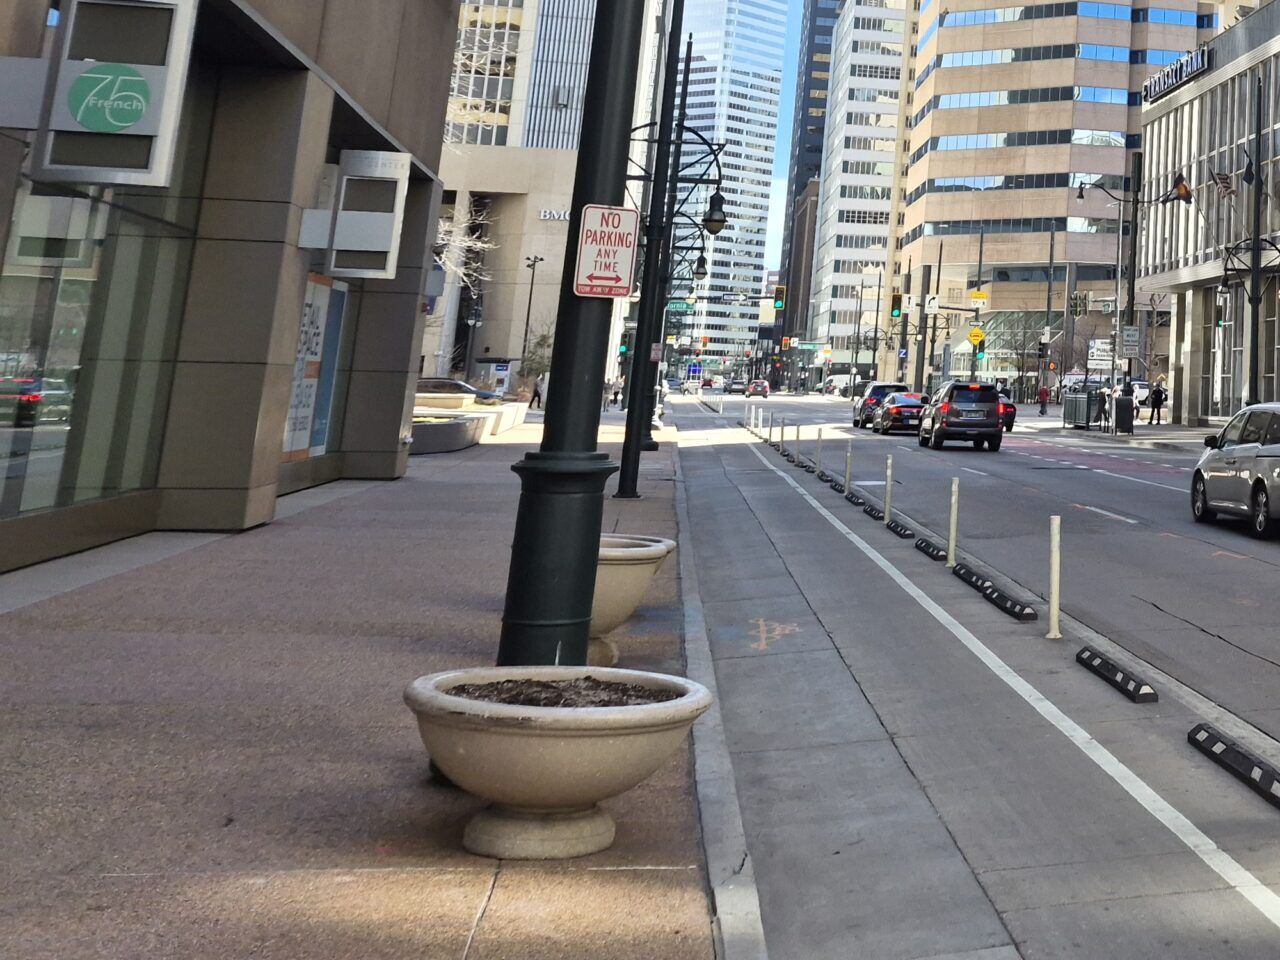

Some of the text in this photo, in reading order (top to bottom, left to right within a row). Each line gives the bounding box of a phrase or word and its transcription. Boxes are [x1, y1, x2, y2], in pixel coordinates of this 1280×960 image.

[88, 96, 143, 110] French
[600, 211, 621, 229] NO
[584, 229, 632, 248] PARKING
[596, 247, 618, 260] ANY
[593, 260, 619, 273] TIME
[578, 285, 591, 293] TOW
[611, 287, 628, 295] ZONE
